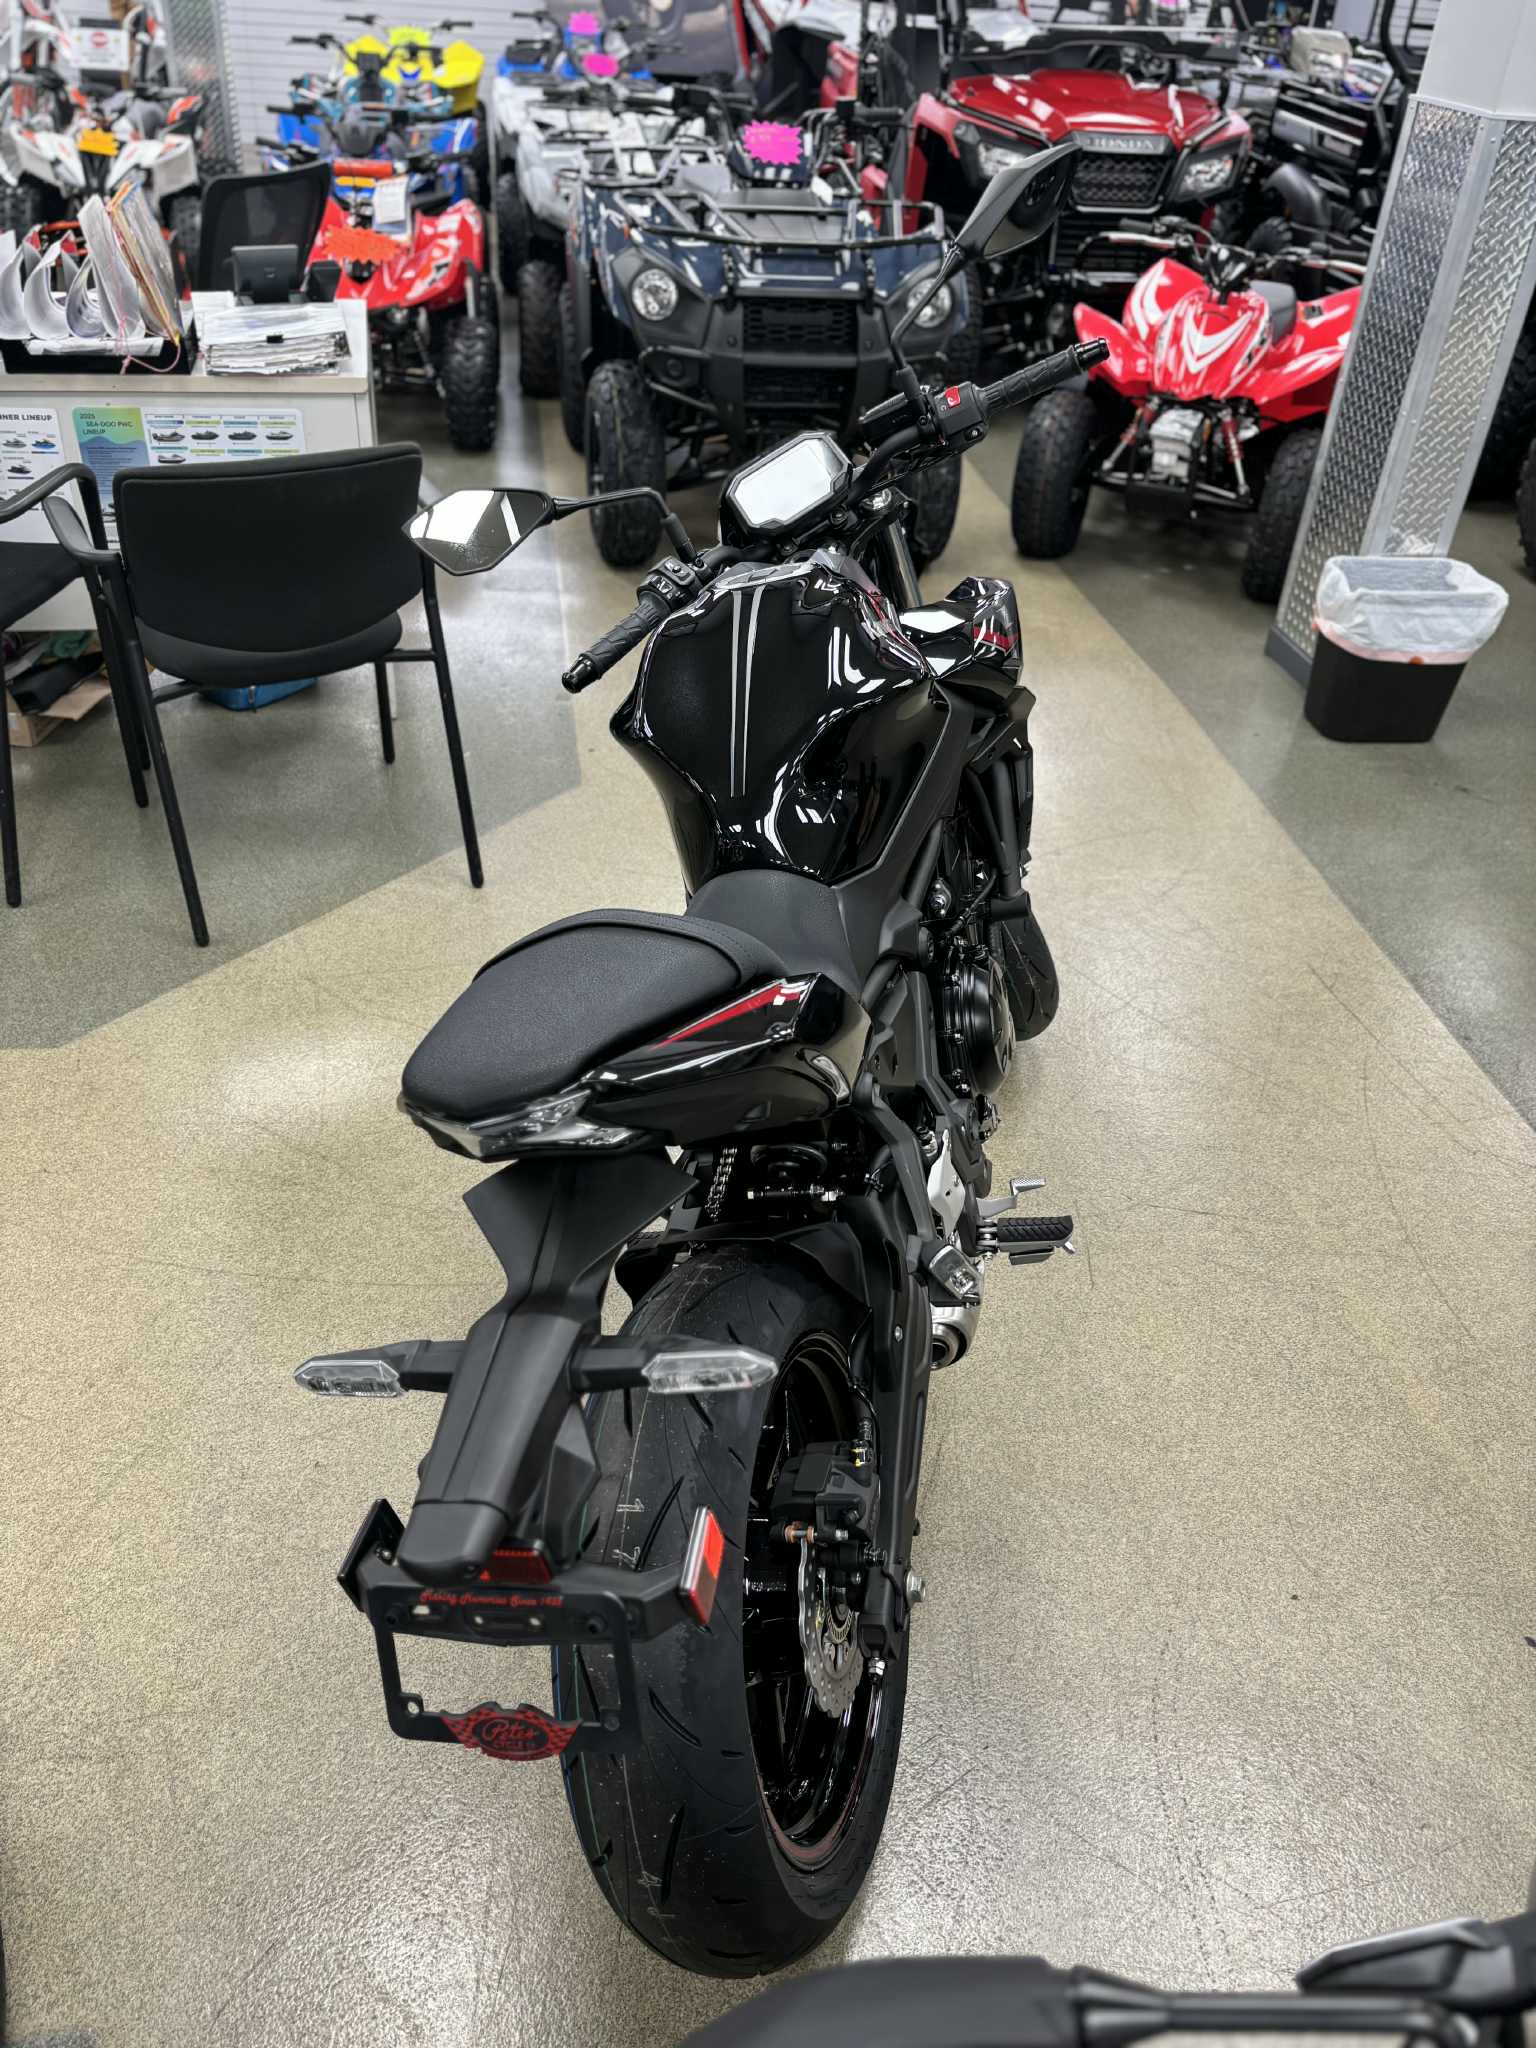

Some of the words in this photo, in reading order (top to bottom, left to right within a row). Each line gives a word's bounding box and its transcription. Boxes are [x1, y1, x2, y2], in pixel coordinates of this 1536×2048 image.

[1087, 137, 1154, 150] HONDA
[0, 413, 20, 421] NER
[21, 413, 53, 421] LINEUP
